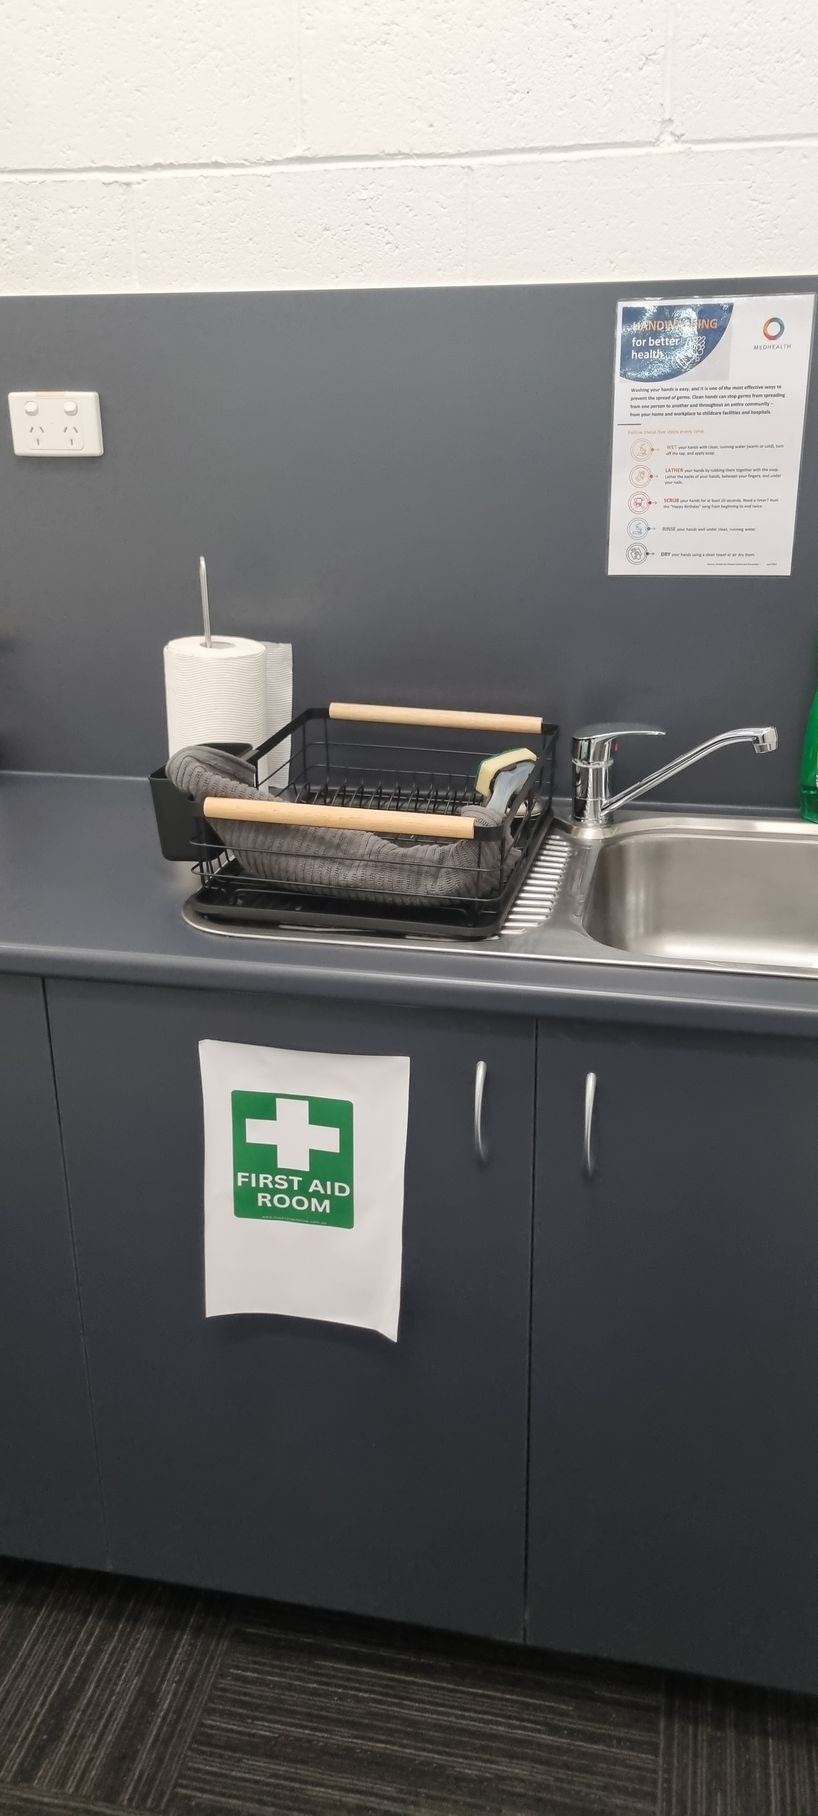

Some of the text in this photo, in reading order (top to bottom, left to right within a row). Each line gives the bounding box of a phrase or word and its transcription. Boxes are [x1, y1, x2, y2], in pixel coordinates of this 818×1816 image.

[631, 336, 680, 348] for better
[237, 1172, 351, 1197] FIRST AID
[257, 1193, 330, 1214] ROOM
